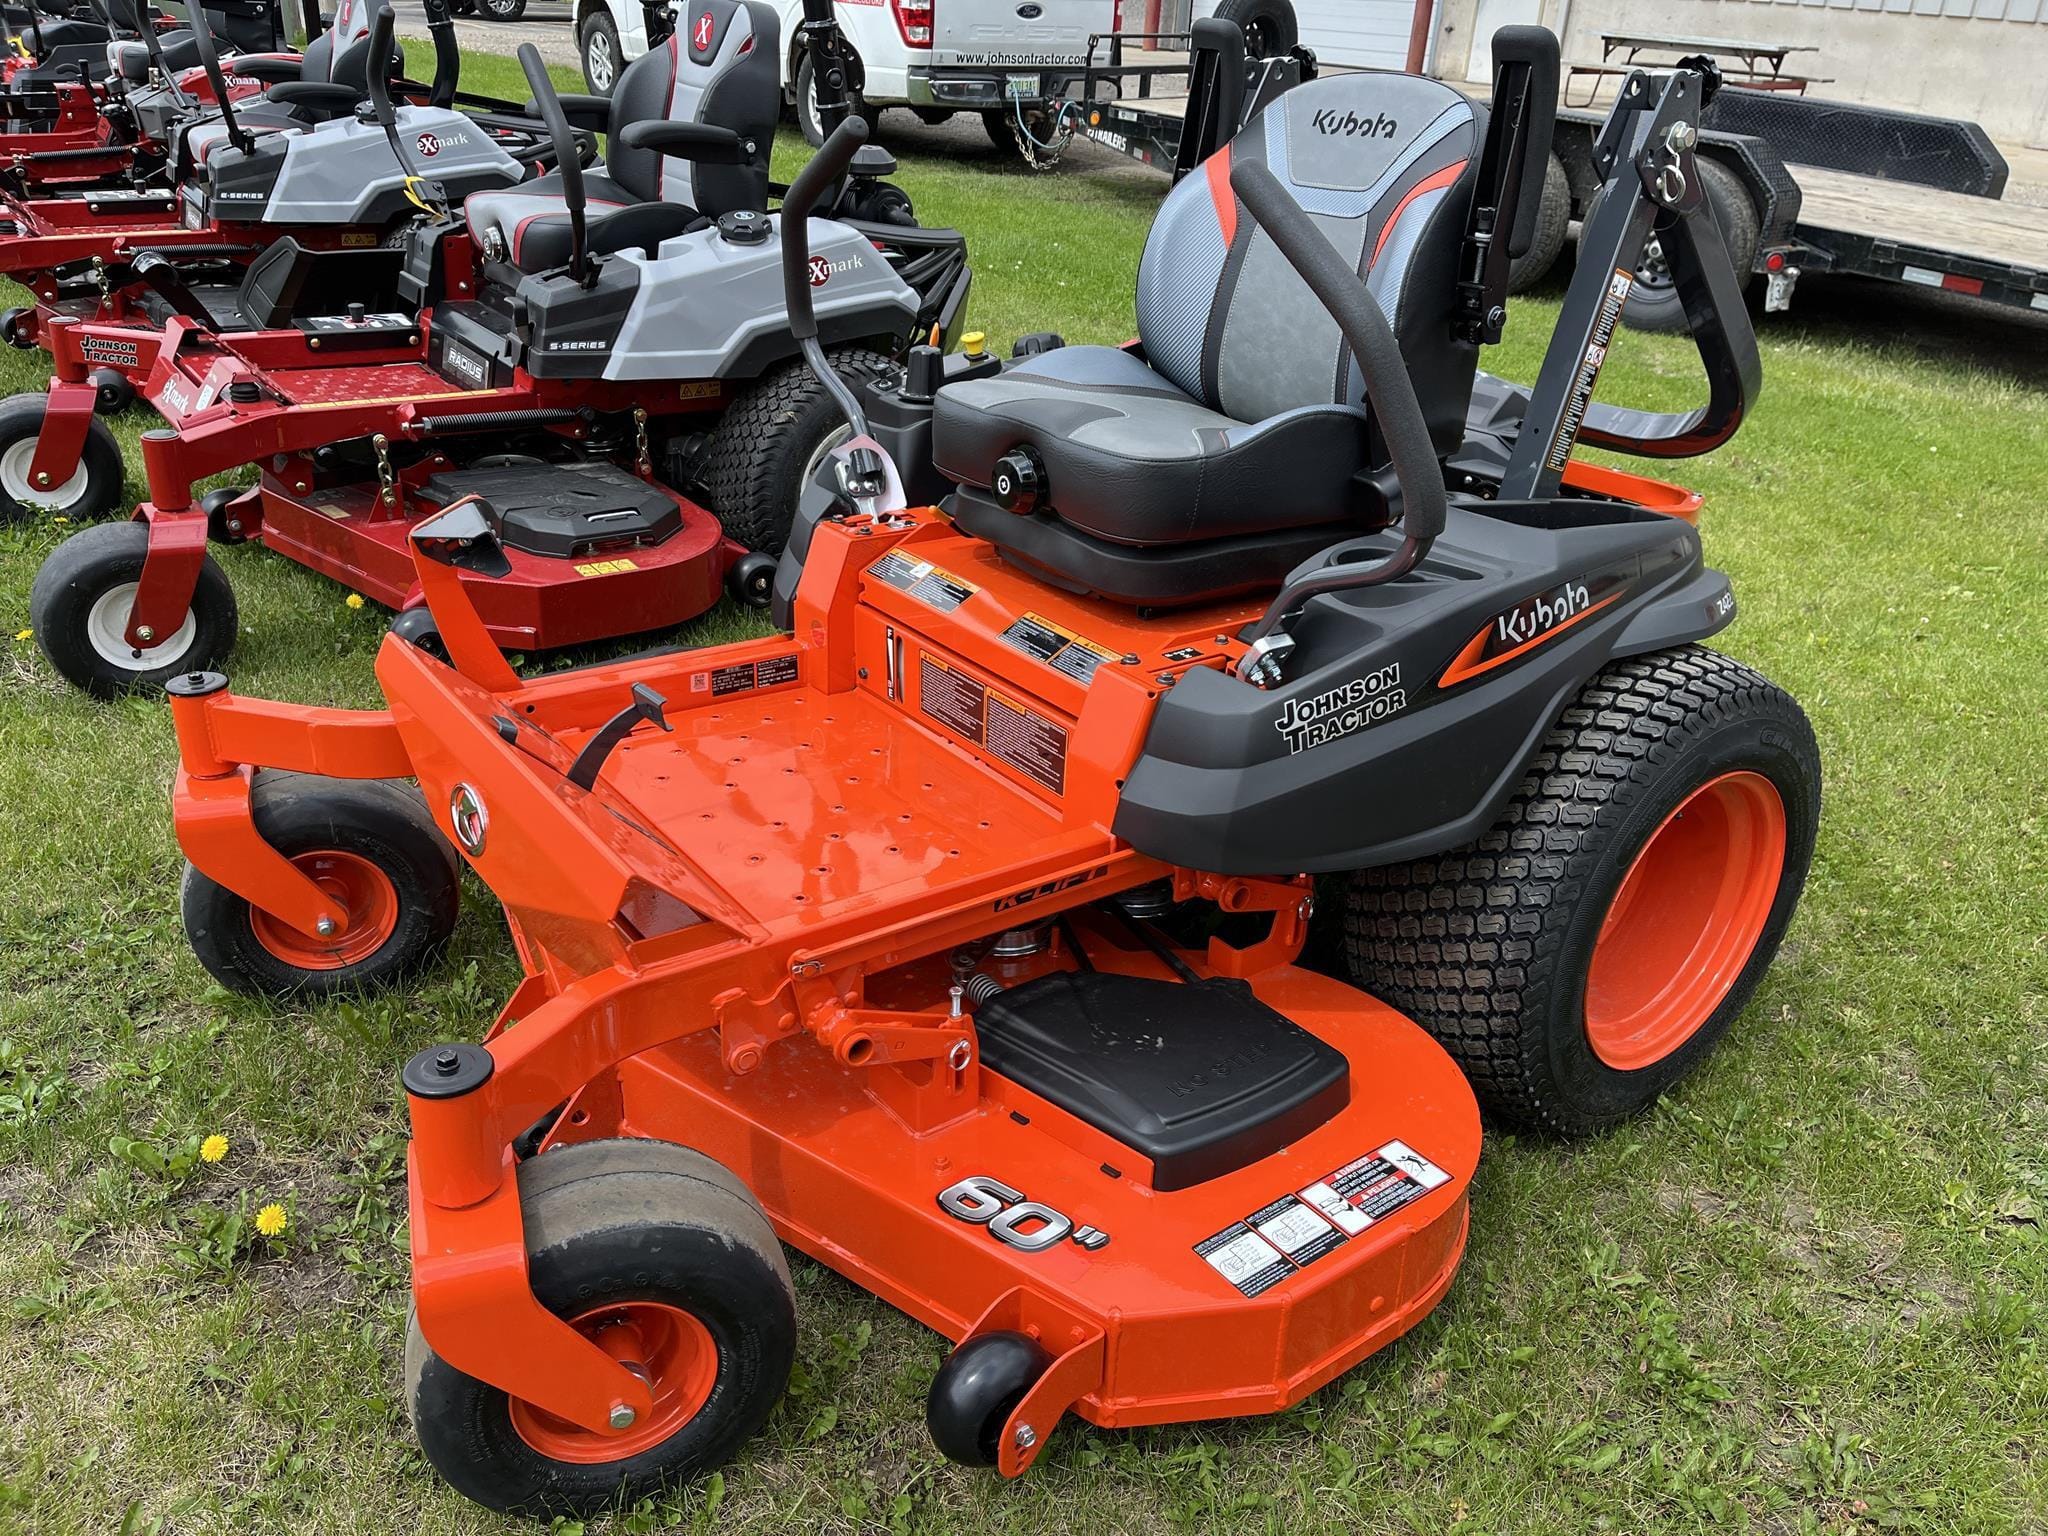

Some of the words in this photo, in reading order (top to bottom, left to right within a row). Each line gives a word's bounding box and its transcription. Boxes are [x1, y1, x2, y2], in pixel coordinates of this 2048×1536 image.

[695, 17, 712, 45] X
[1312, 108, 1398, 139] Kubota
[416, 132, 469, 154] eXmark
[80, 335, 137, 352] JOHNSON
[83, 348, 138, 366] TRACTOR
[448, 347, 483, 383] RADIUS
[1498, 582, 1590, 643] Kubota
[1275, 662, 1400, 732] JOHNSON
[1283, 689, 1407, 756] TRACTOR
[1338, 1156, 1371, 1176] DANGER
[1365, 1175, 1399, 1195] PELIGRO
